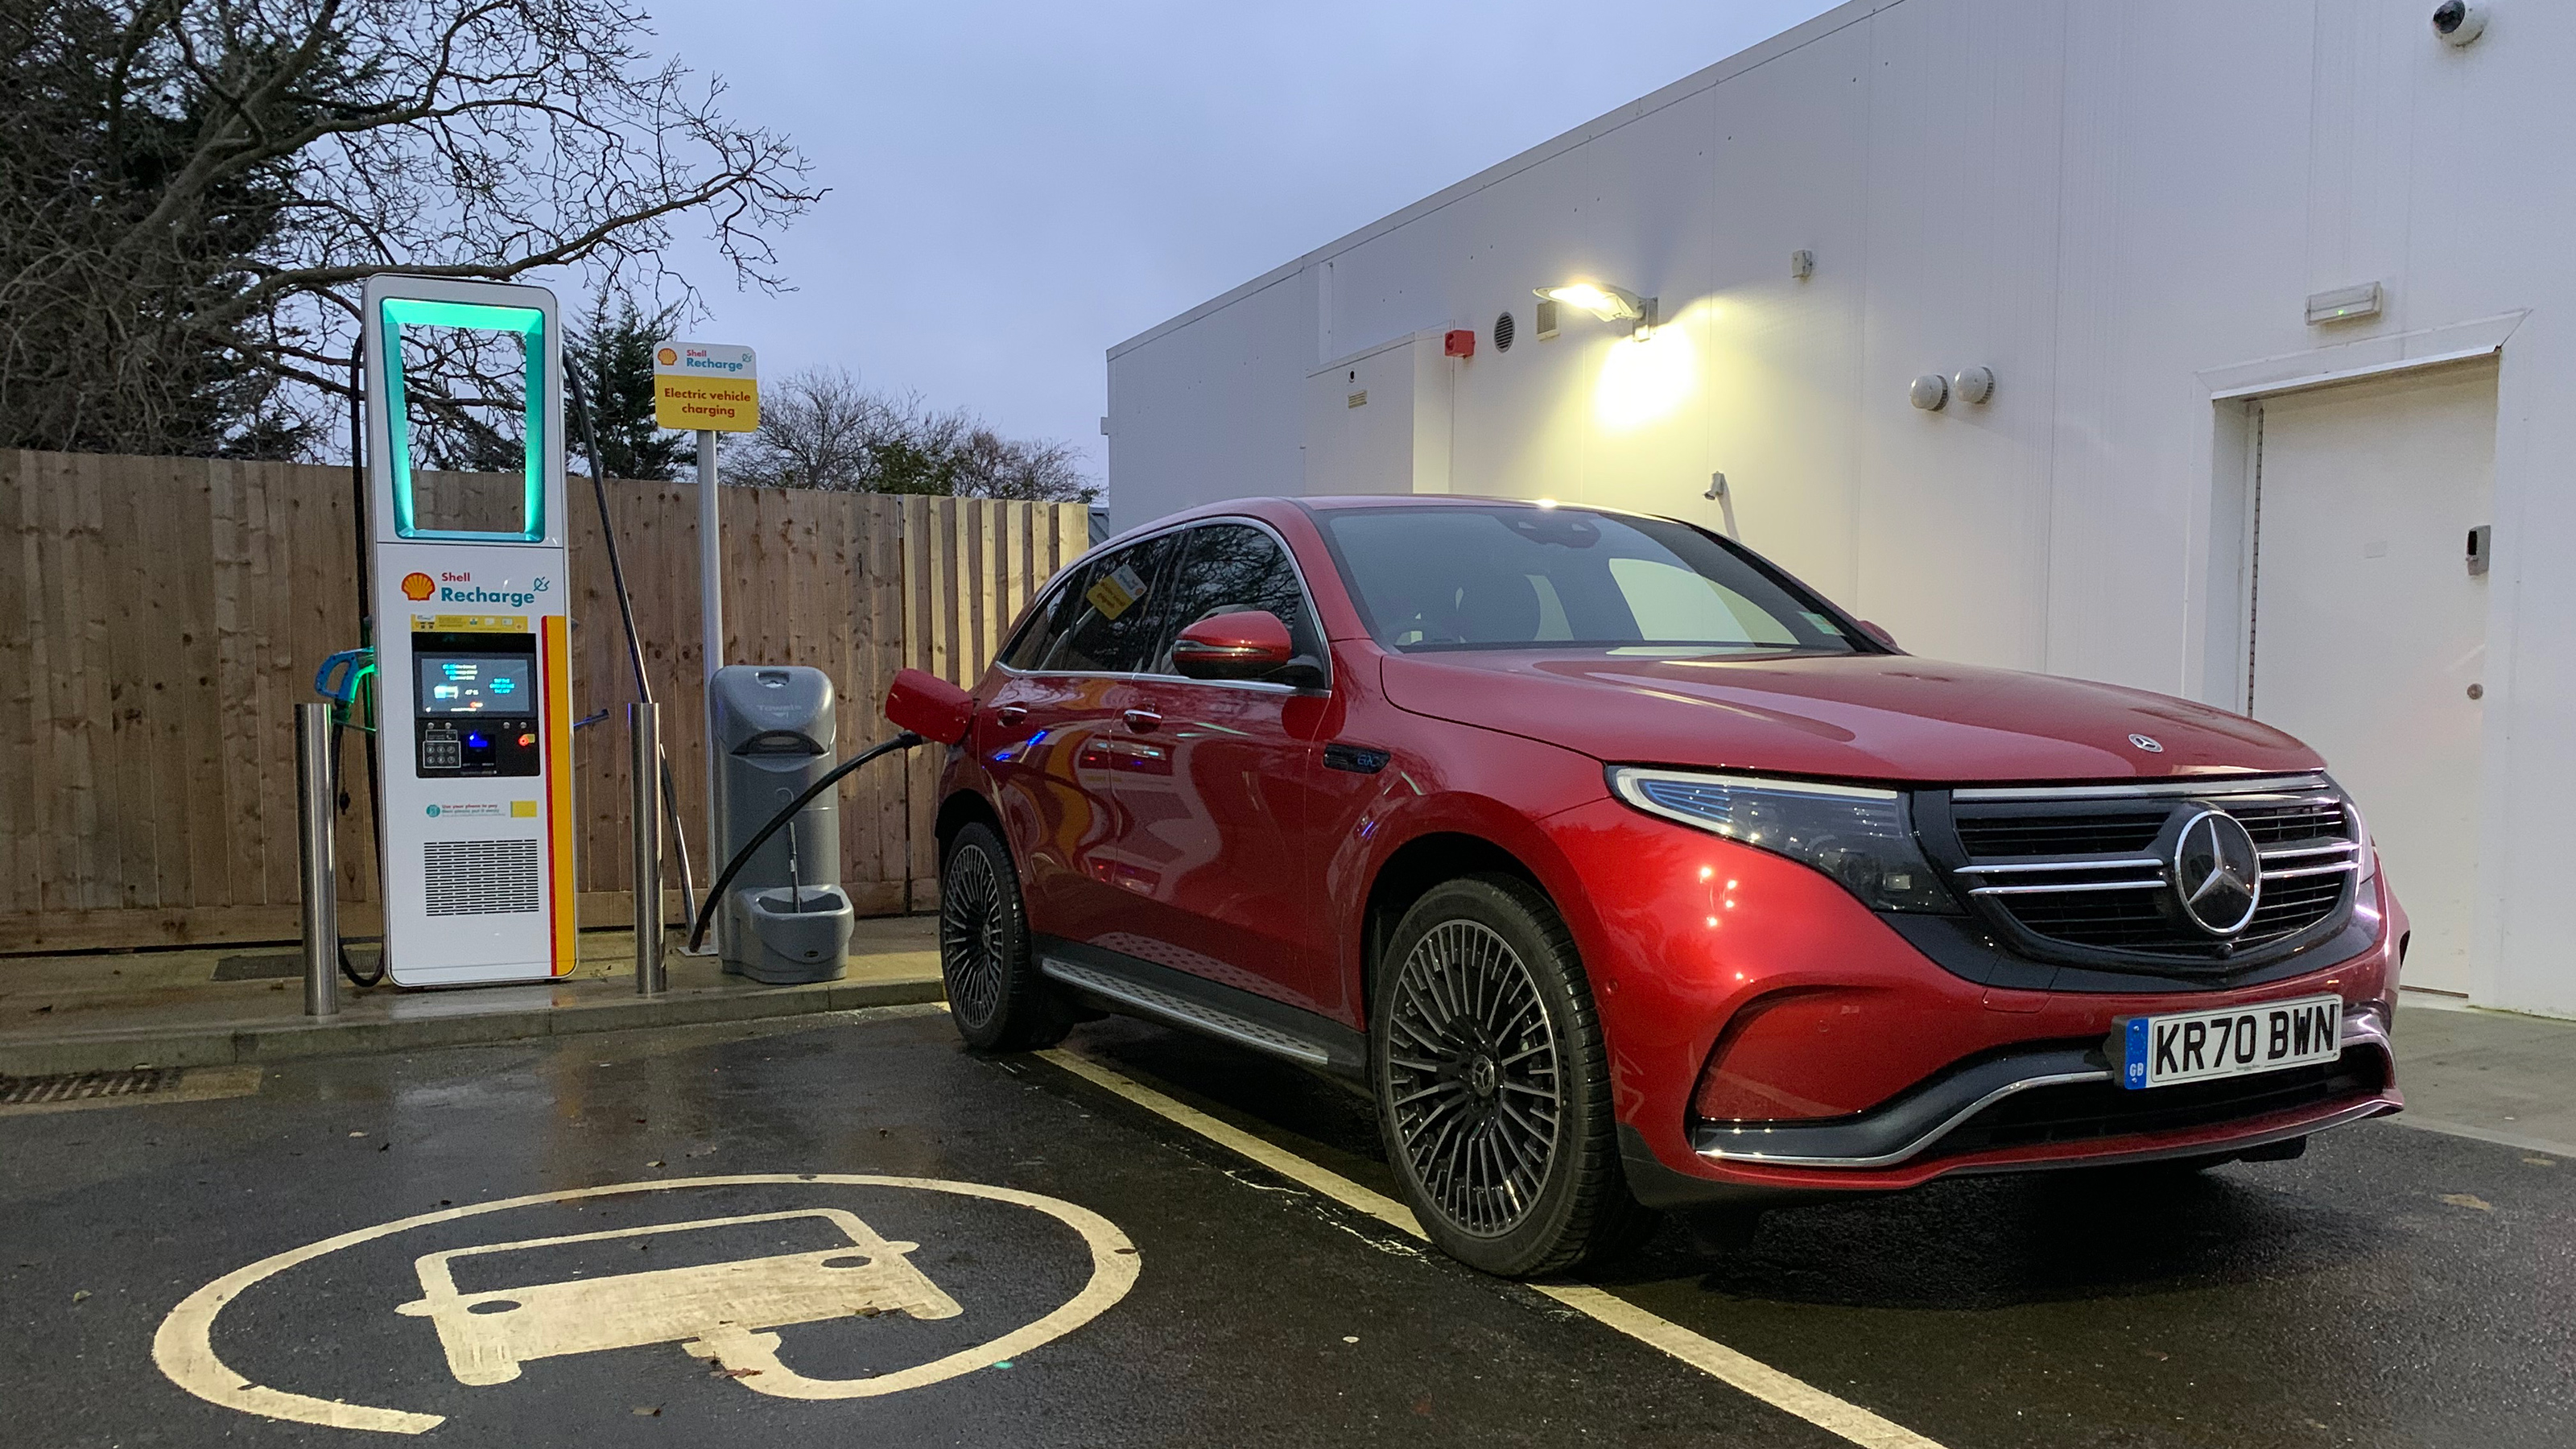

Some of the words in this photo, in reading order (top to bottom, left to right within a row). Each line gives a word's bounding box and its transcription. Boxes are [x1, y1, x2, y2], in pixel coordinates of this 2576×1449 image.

[686, 349, 707, 357] Shell
[686, 357, 743, 372] Recharge
[664, 387, 707, 400] Electric
[709, 390, 751, 402] vehicle
[681, 403, 735, 418] charging
[441, 572, 471, 582] Shell
[440, 586, 535, 608] Recharge
[1357, 753, 1380, 767] EQC
[2155, 1015, 2257, 1075] KR70
[2267, 1003, 2335, 1060] BWN
[2129, 1062, 2145, 1077] GB
